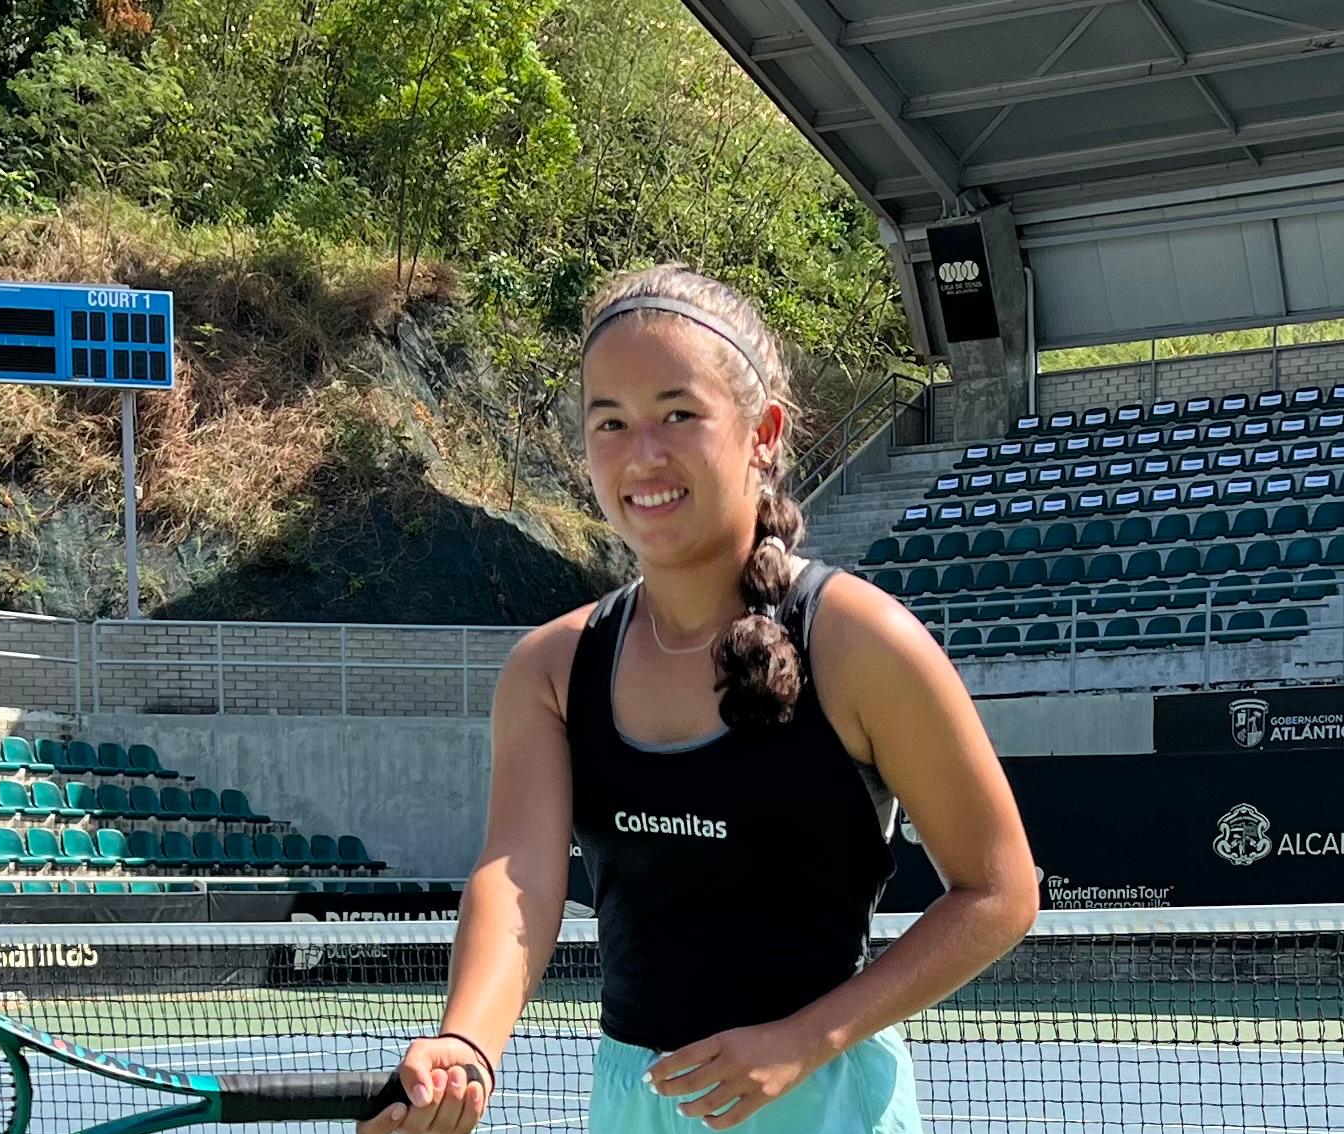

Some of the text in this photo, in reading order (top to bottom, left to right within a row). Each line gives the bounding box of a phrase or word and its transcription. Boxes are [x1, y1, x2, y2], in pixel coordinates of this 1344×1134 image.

[87, 290, 151, 310] COURT 1
[614, 810, 728, 839] Colsanitas
